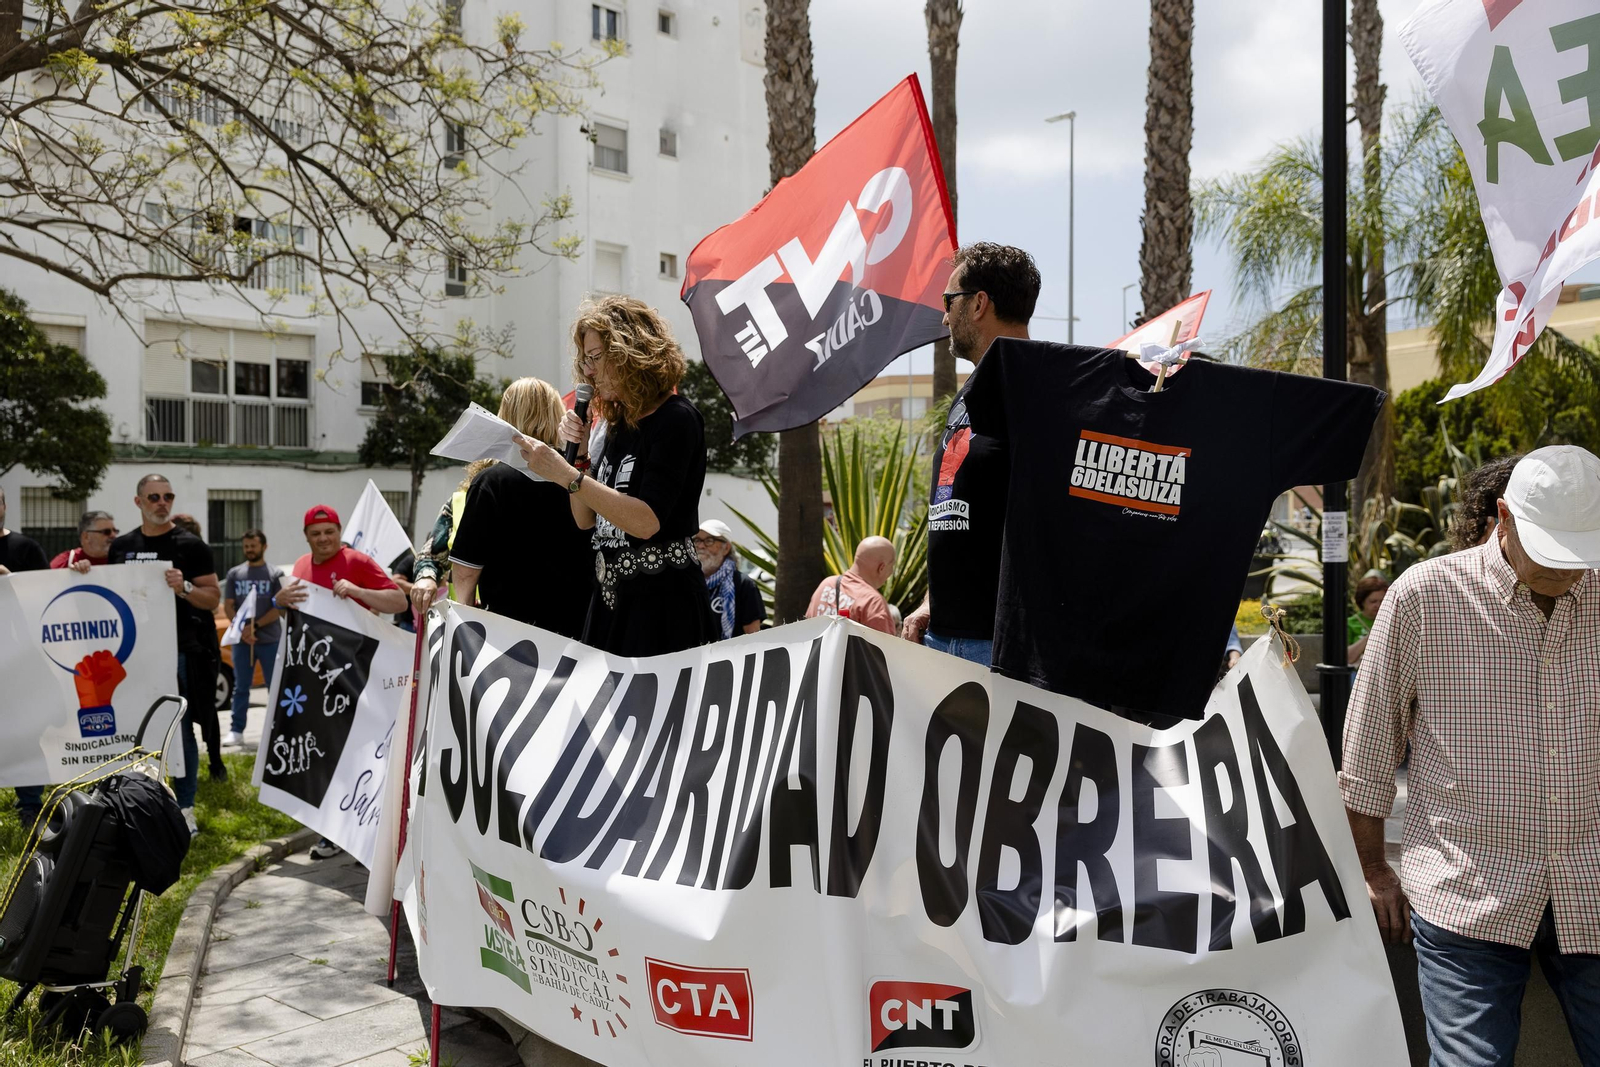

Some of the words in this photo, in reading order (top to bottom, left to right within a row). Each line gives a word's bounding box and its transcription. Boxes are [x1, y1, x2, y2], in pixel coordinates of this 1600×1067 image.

[1074, 438, 1188, 485] LLIBERTÁ
[1070, 466, 1182, 506] 6DELASUIZA
[931, 517, 970, 531] REPRESIÓN
[42, 618, 119, 643] ACERINOX
[61, 756, 79, 766] SIN
[65, 733, 137, 752] SINDICALISMO
[439, 618, 895, 898] SOLIDARIDAD
[915, 673, 1352, 954] OBRERA
[526, 939, 611, 984] CONFLUENCIA
[529, 955, 615, 1003] SINDICAL
[538, 973, 569, 993] BAHÍA
[569, 985, 582, 999] DE
[582, 991, 612, 1013] CÁDIZ
[655, 978, 741, 1021] CTA
[880, 998, 960, 1031] CNT
